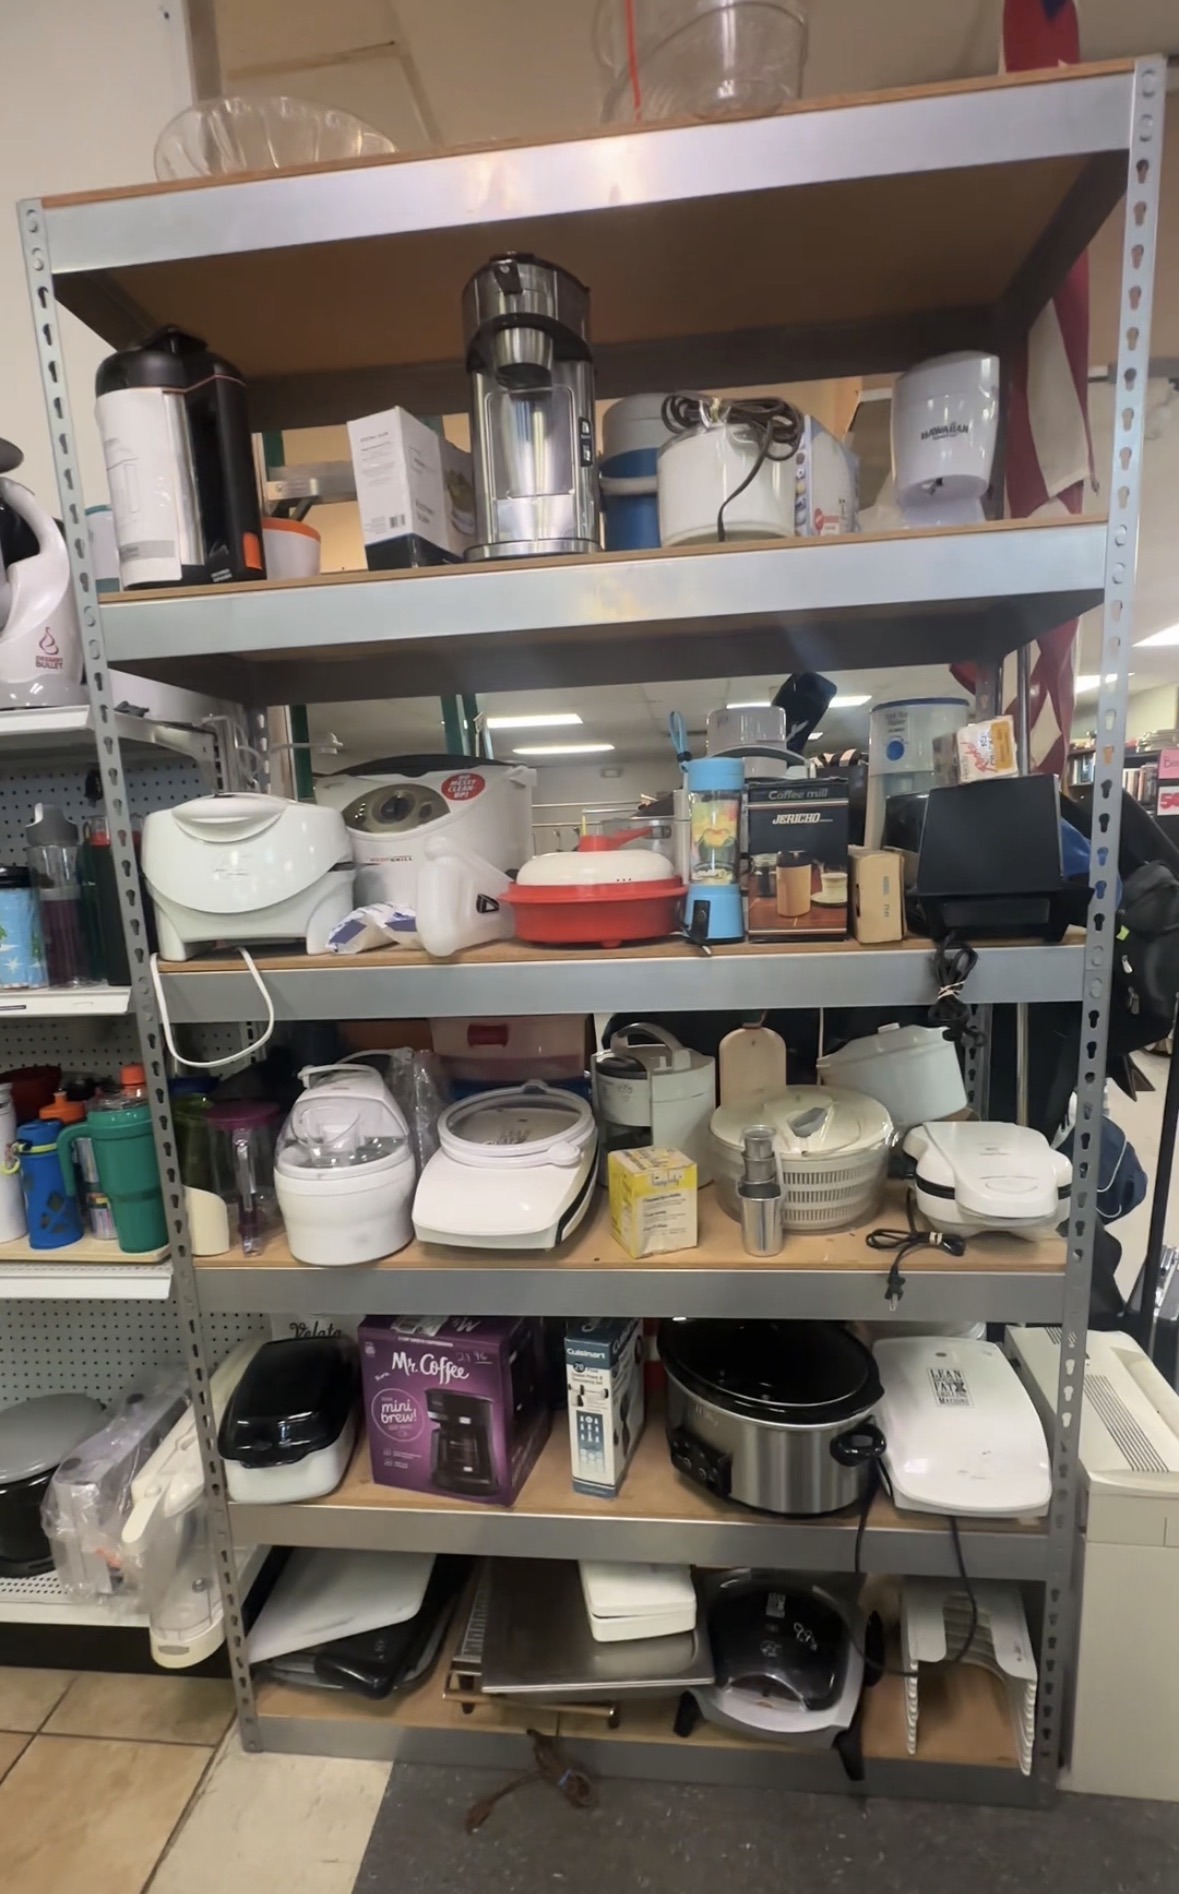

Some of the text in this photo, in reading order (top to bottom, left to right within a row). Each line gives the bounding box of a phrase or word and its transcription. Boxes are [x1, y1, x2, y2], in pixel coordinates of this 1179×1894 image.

[768, 787, 829, 801] Coffee mill
[772, 812, 821, 825] JERICHO
[289, 1320, 342, 1338] Velata
[566, 1347, 606, 1360] Cuisinart
[391, 1351, 470, 1385] Mr. Coffee
[929, 1368, 962, 1381] LEAN
[381, 1398, 412, 1413] mini
[380, 1408, 417, 1424] brew!
